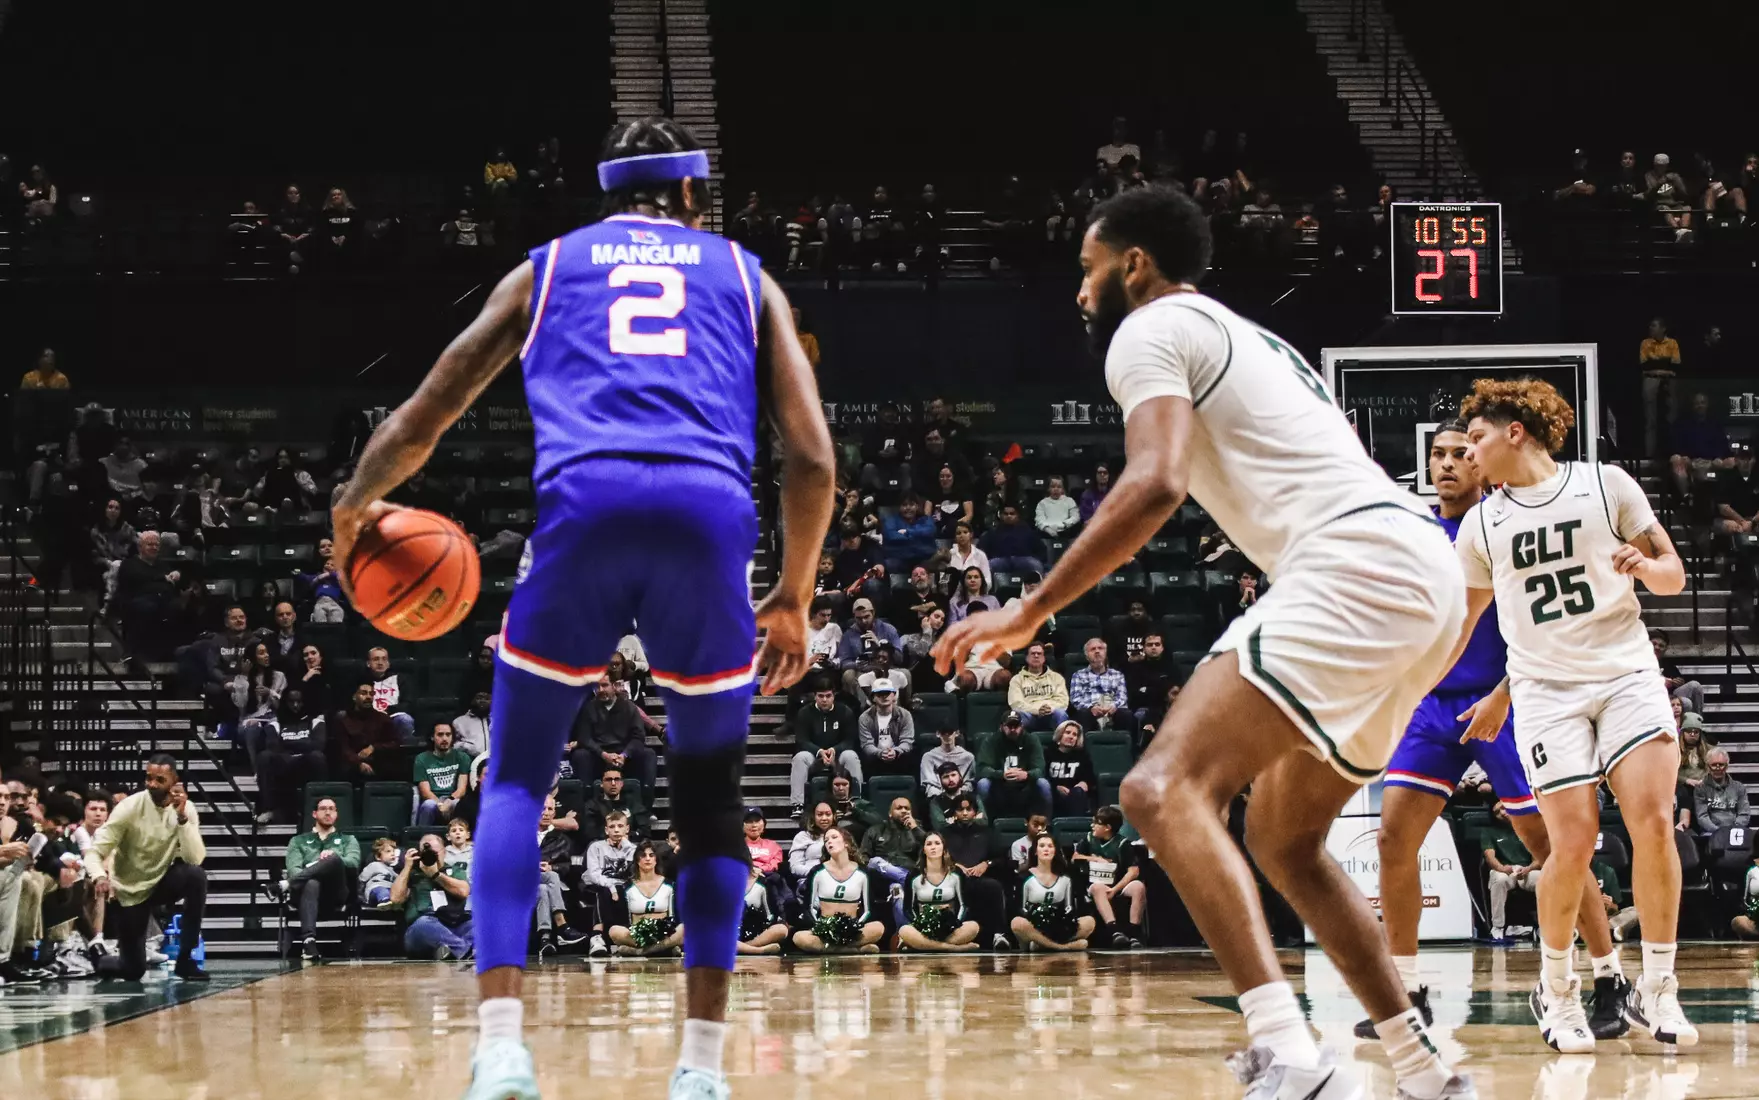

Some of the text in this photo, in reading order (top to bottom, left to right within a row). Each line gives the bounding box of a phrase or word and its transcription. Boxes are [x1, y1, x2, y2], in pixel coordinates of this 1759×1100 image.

[1414, 216, 1488, 245] 10 55
[591, 243, 701, 266] MANGUM
[1414, 248, 1479, 302] 27
[607, 263, 688, 357] 2
[488, 406, 519, 419] Where
[955, 402, 996, 413] students
[1349, 396, 1419, 406] AMERICAN
[123, 408, 191, 419] AMERICAN
[1512, 519, 1582, 570] CLT
[1525, 565, 1595, 625] 25
[1531, 742, 1548, 769] C
[1050, 761, 1080, 779] CLT
[833, 885, 846, 899] C
